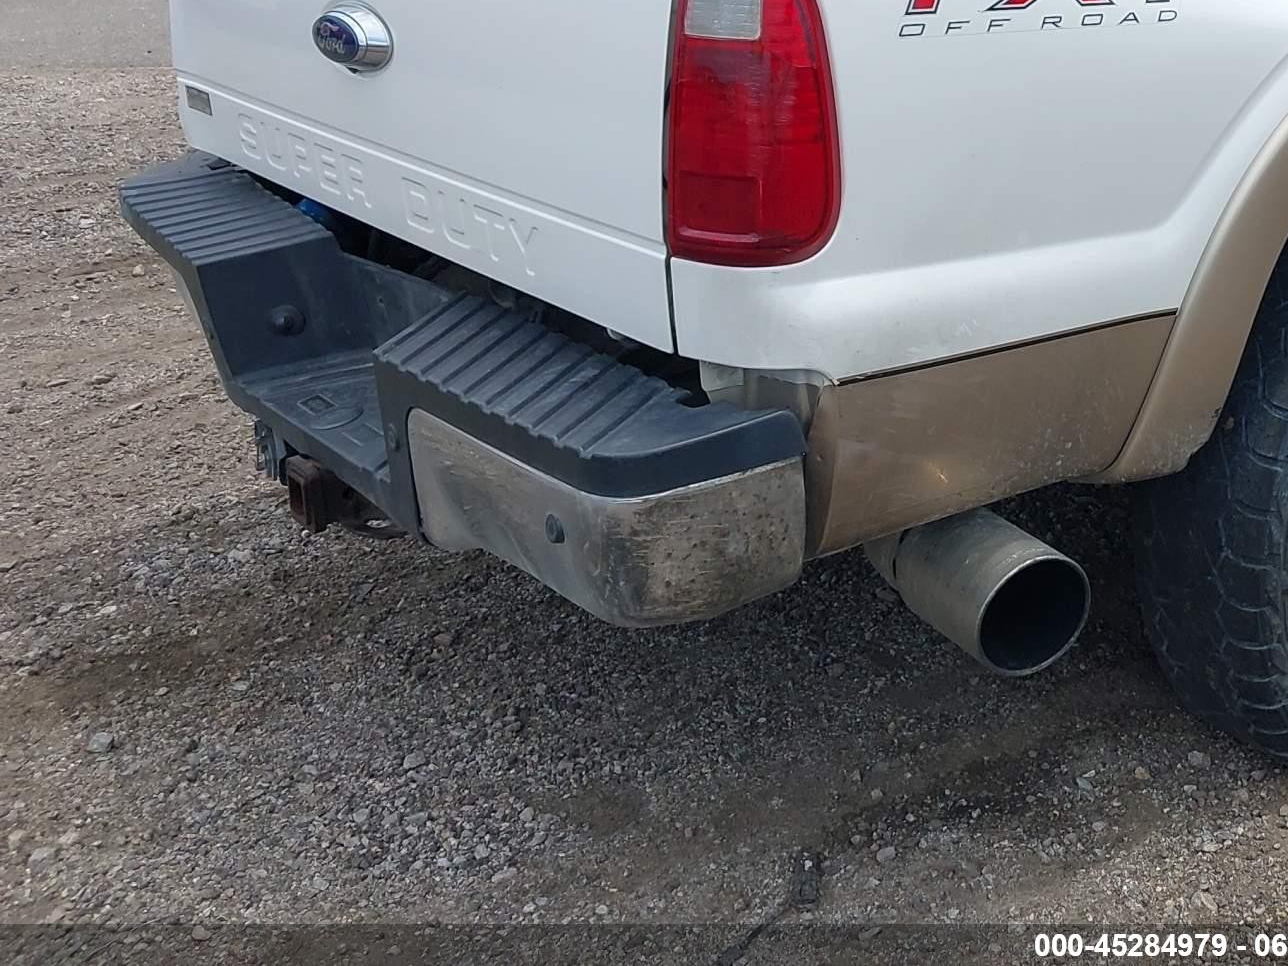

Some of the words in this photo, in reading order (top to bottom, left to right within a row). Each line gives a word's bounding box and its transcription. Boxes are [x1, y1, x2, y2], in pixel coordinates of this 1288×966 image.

[316, 21, 347, 54] Ford
[898, 18, 1012, 37] OFF
[1040, 9, 1178, 30] ROAD
[237, 112, 372, 209] SUPER
[401, 176, 539, 277] DUTY
